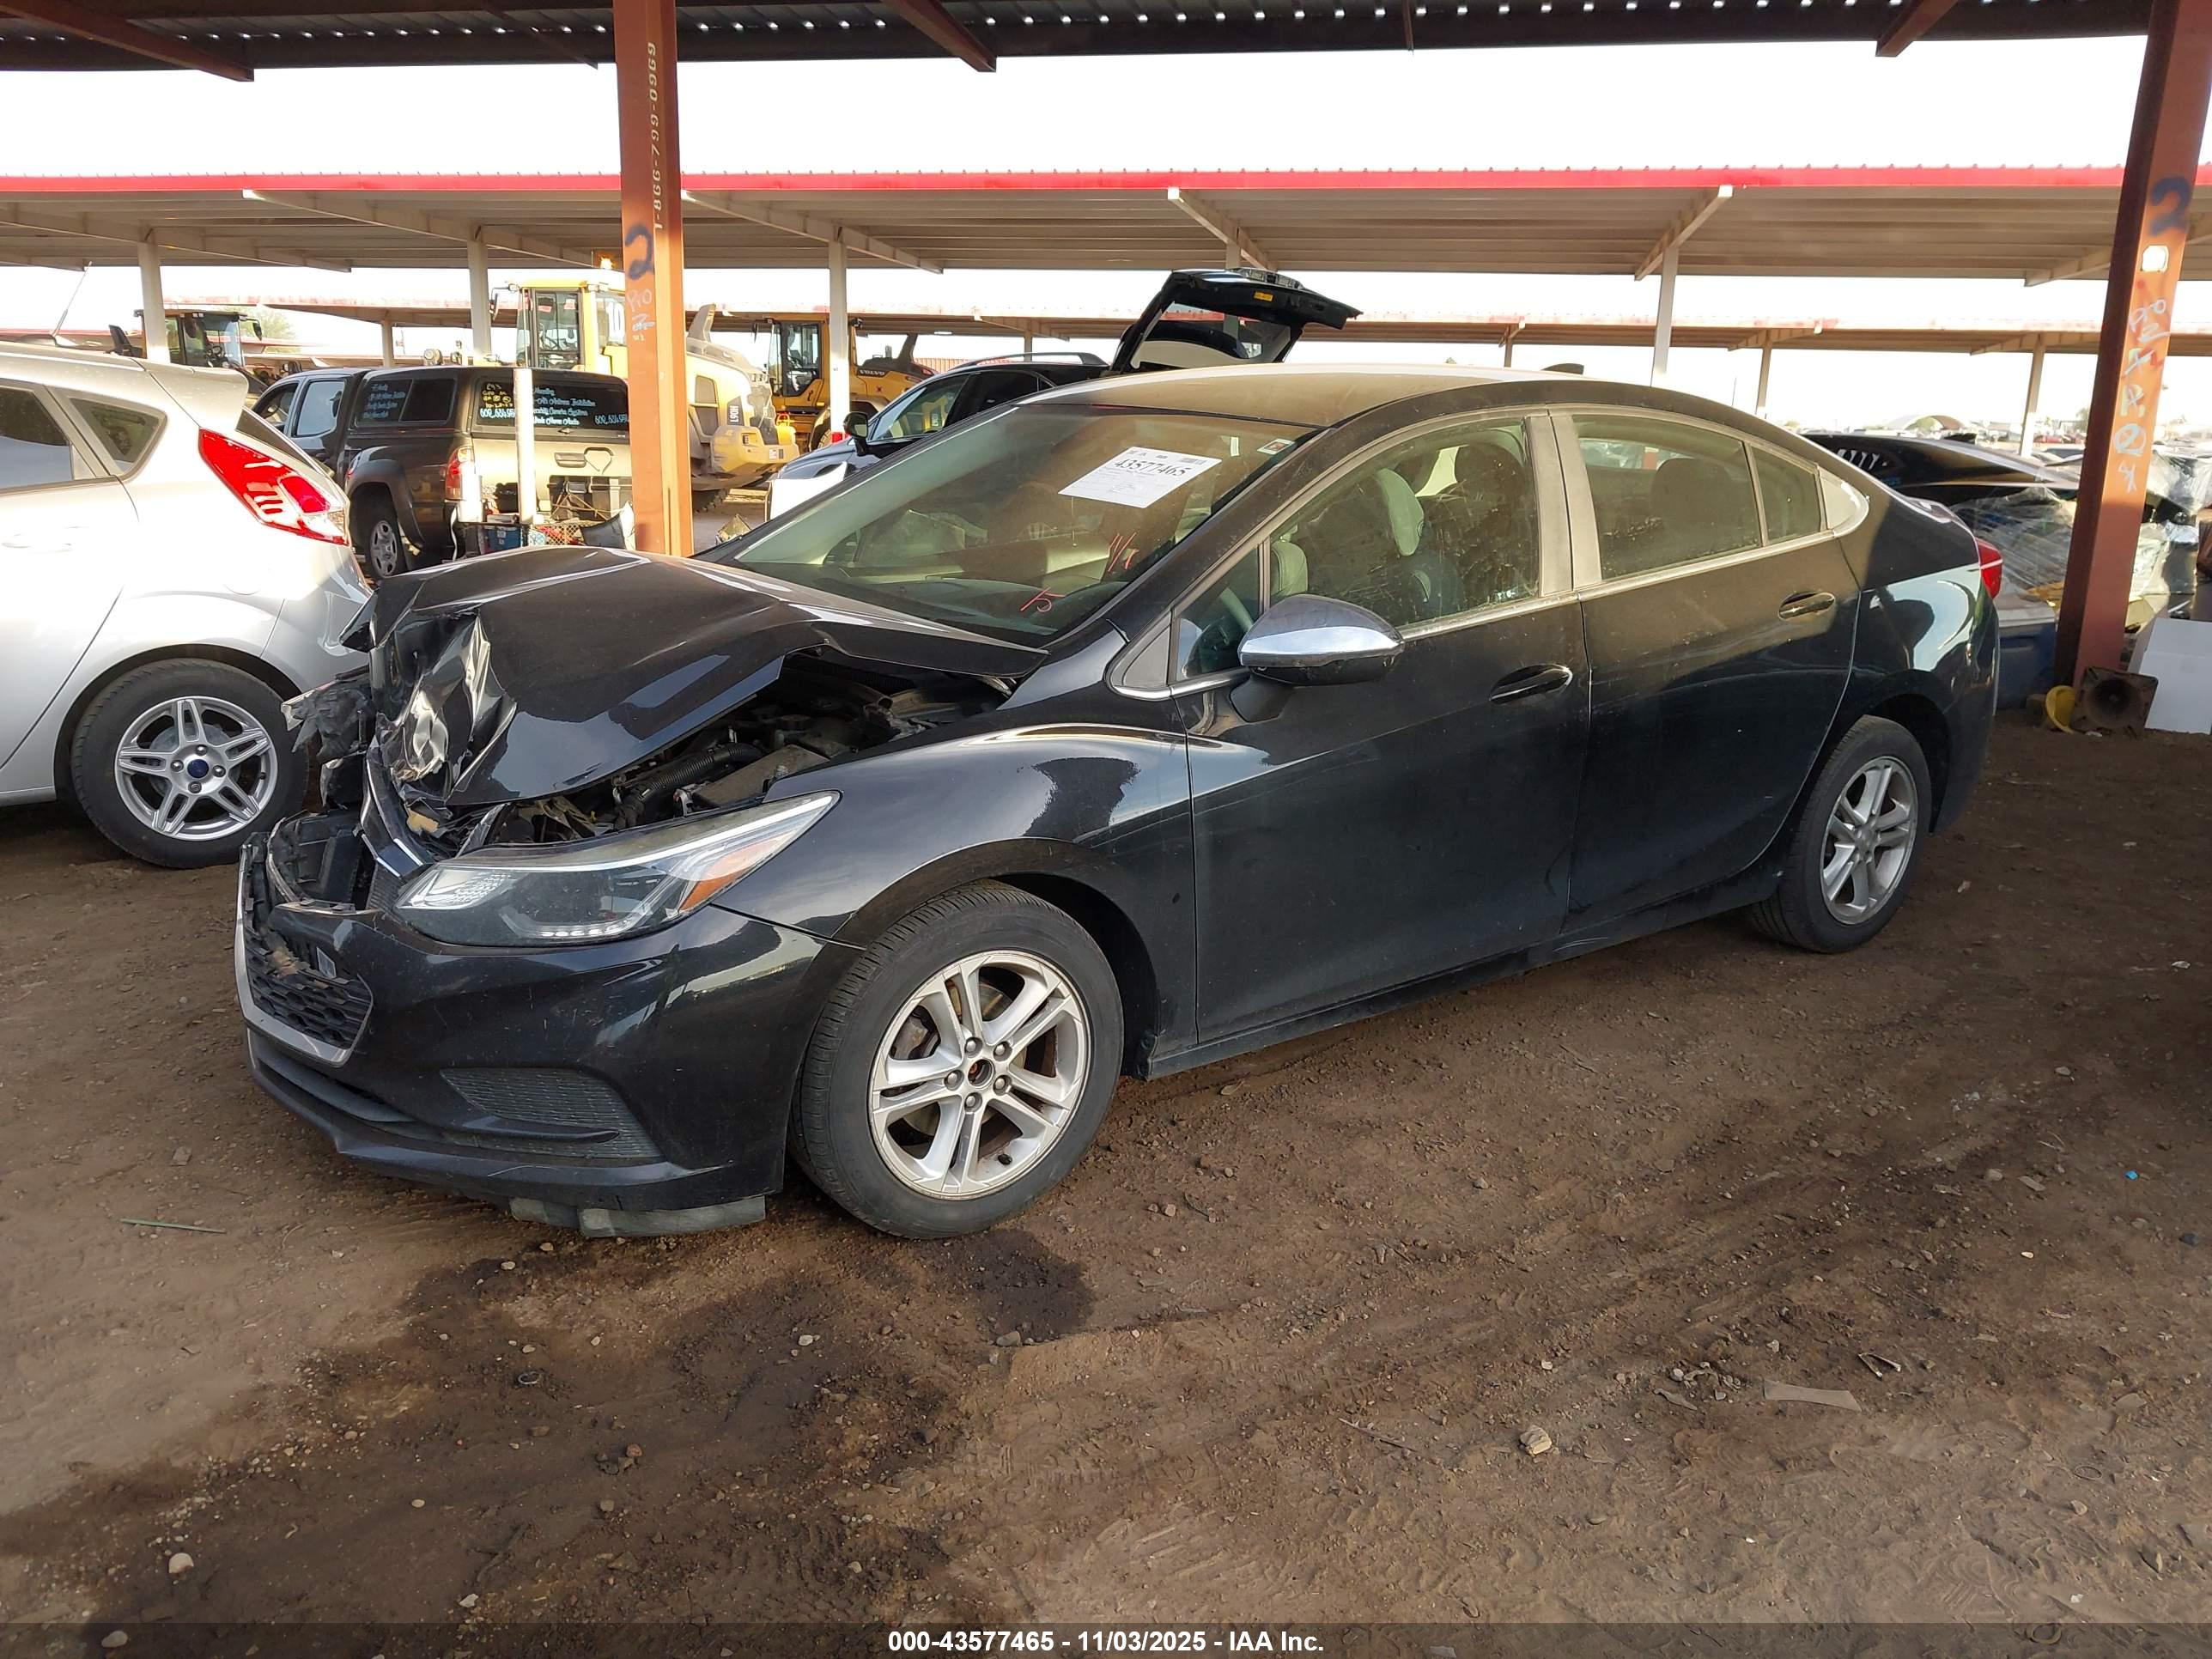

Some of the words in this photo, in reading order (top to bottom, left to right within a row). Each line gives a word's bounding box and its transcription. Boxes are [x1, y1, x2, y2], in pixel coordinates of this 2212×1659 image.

[2149, 176, 2191, 237] 2
[625, 224, 654, 281] 2
[1114, 459, 1191, 477] 43577465
